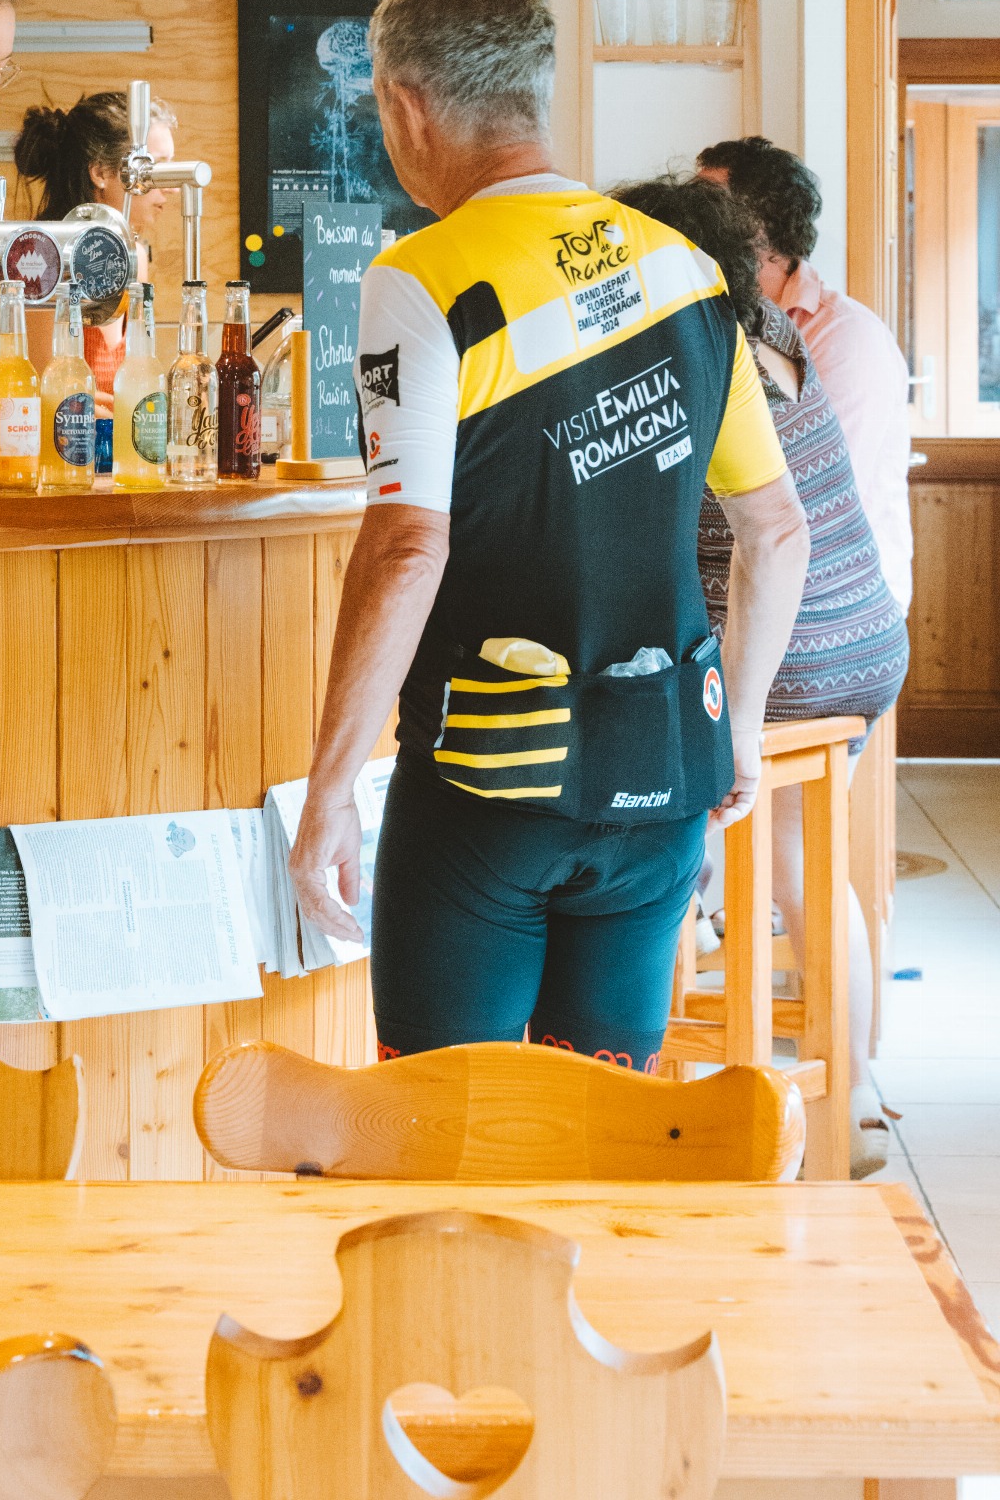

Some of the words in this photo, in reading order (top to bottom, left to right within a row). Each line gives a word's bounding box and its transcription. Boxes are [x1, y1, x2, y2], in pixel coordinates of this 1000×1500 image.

[313, 214, 358, 246] Boisson
[361, 225, 374, 247] du
[601, 243, 611, 253] de
[329, 259, 362, 284] moment
[575, 287, 601, 305] GRAND
[602, 270, 632, 293] DÉPART
[587, 288, 625, 314] FLORENCE
[577, 291, 642, 332] ÉMILIE-ROMAGNE
[600, 317, 620, 335] 2024
[315, 324, 355, 372] Schorle
[317, 380, 350, 409] Raisin
[596, 368, 681, 427] EMILIA
[568, 399, 687, 485] ROMAGNA
[661, 439, 689, 466] ITALY
[611, 787, 672, 809] Santini
